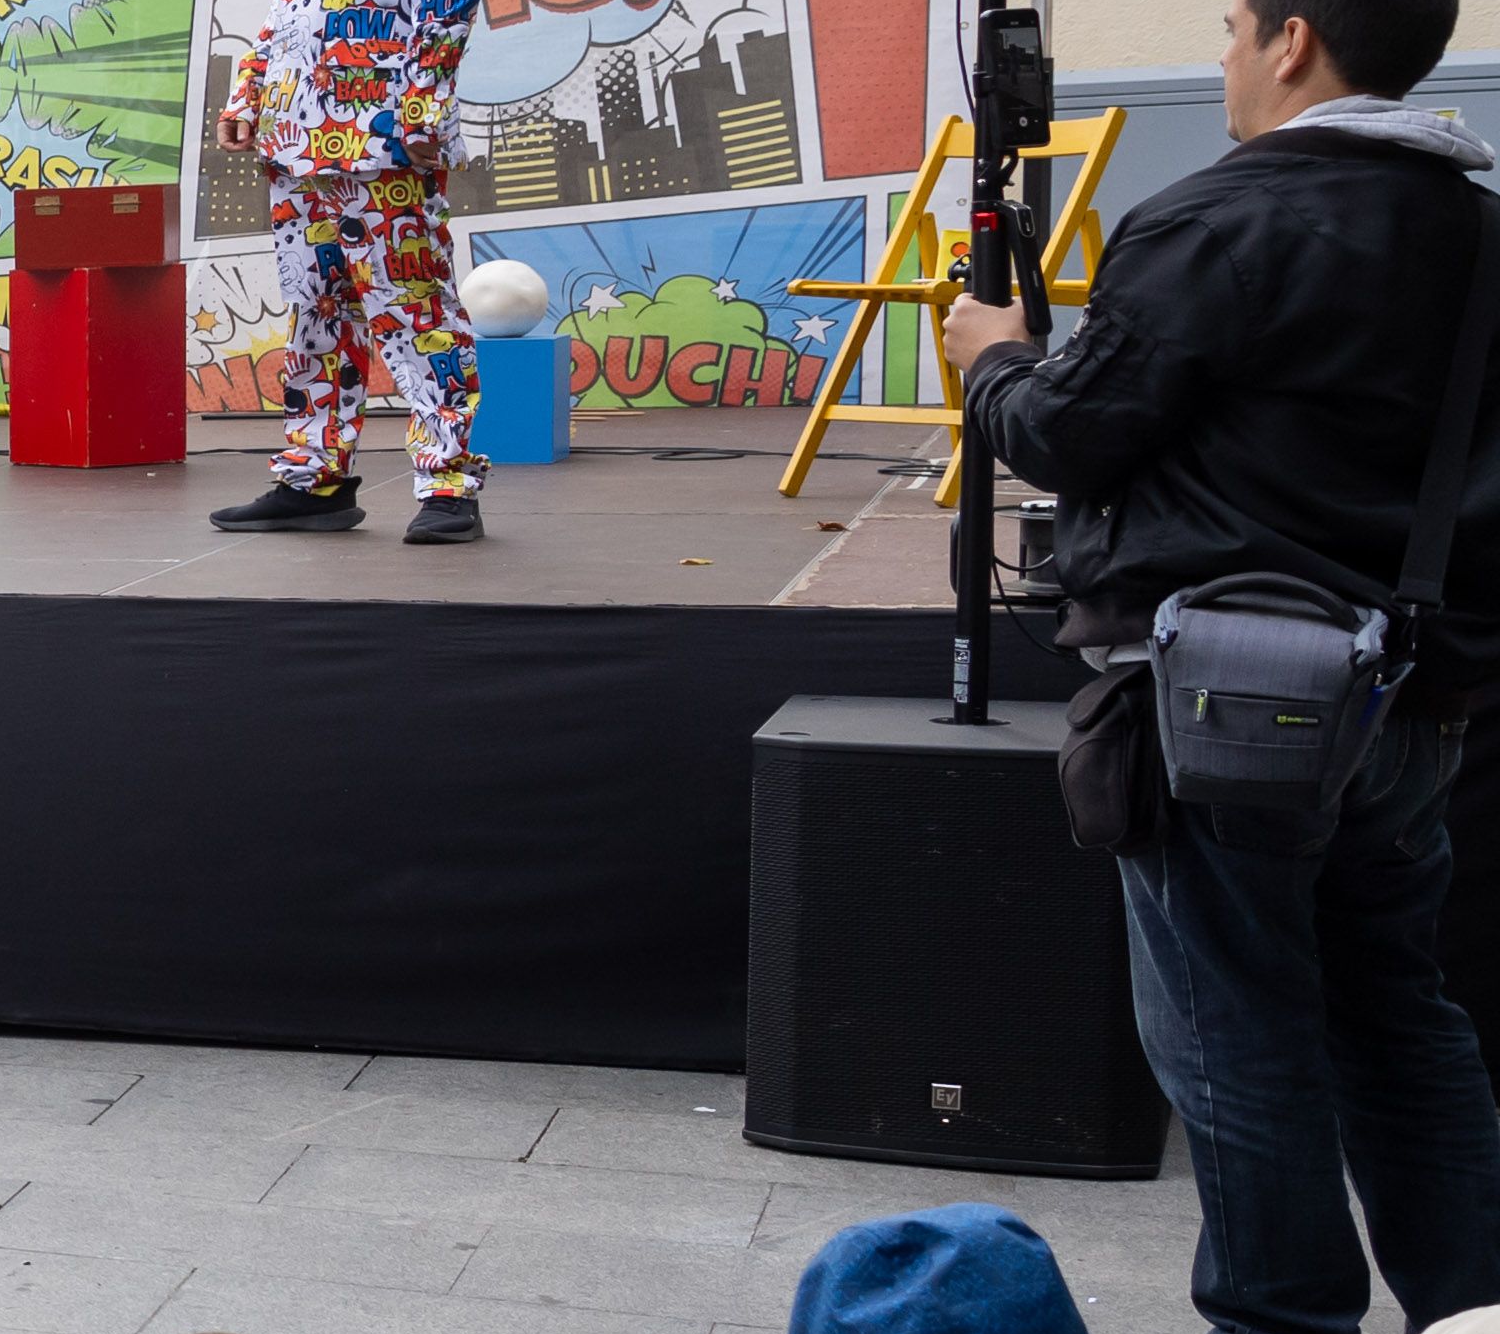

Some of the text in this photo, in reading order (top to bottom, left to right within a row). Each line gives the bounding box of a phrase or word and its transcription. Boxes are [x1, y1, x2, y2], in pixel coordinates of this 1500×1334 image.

[324, 7, 397, 41] POW
[335, 77, 388, 102] BAM
[309, 126, 370, 161] POW
[367, 174, 425, 212] POW
